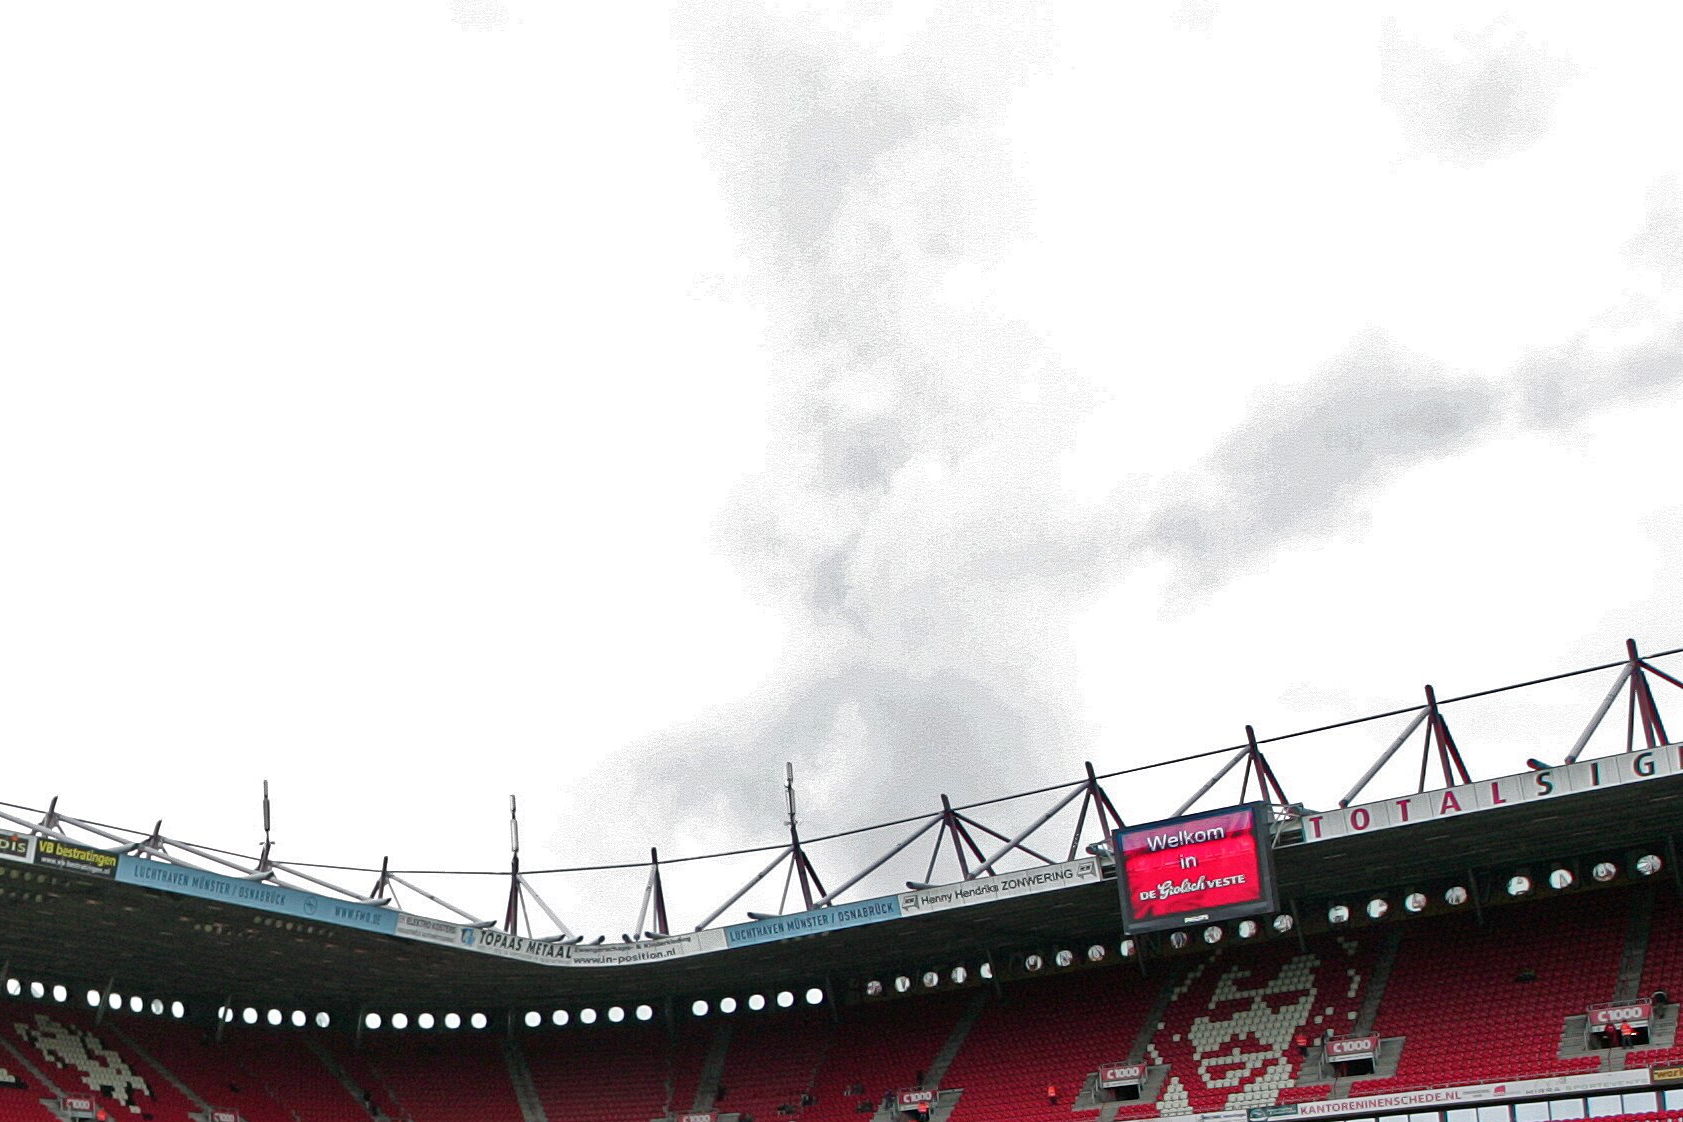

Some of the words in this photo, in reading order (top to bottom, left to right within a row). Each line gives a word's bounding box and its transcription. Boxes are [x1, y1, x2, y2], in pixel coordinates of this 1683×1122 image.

[1147, 827, 1225, 852] Welkom
[39, 840, 54, 854] VB
[56, 842, 117, 867] bestratingen
[1179, 854, 1197, 869] in
[134, 864, 189, 887] LUCHTHAVEN
[192, 874, 231, 896] MÜNSTER
[239, 885, 287, 906] OSNABRÜCK
[921, 891, 953, 907] Henny
[1001, 868, 1074, 892] ZONWERING
[1139, 890, 1157, 901] DE
[1206, 874, 1246, 888] VESTE
[729, 919, 785, 942] LUCHTHAVEN
[787, 912, 829, 933] MÜNSTER
[838, 902, 894, 924] OSNABRÜCK
[479, 930, 523, 952] TOPAAS
[525, 941, 573, 959] METAAL
[1596, 1006, 1643, 1023] C1000
[1333, 1039, 1371, 1053] C1000
[1106, 1066, 1140, 1080] C1000
[904, 1091, 933, 1103] C1000
[1300, 1092, 1462, 1115] KANTORENINENSCHEDE.NL
